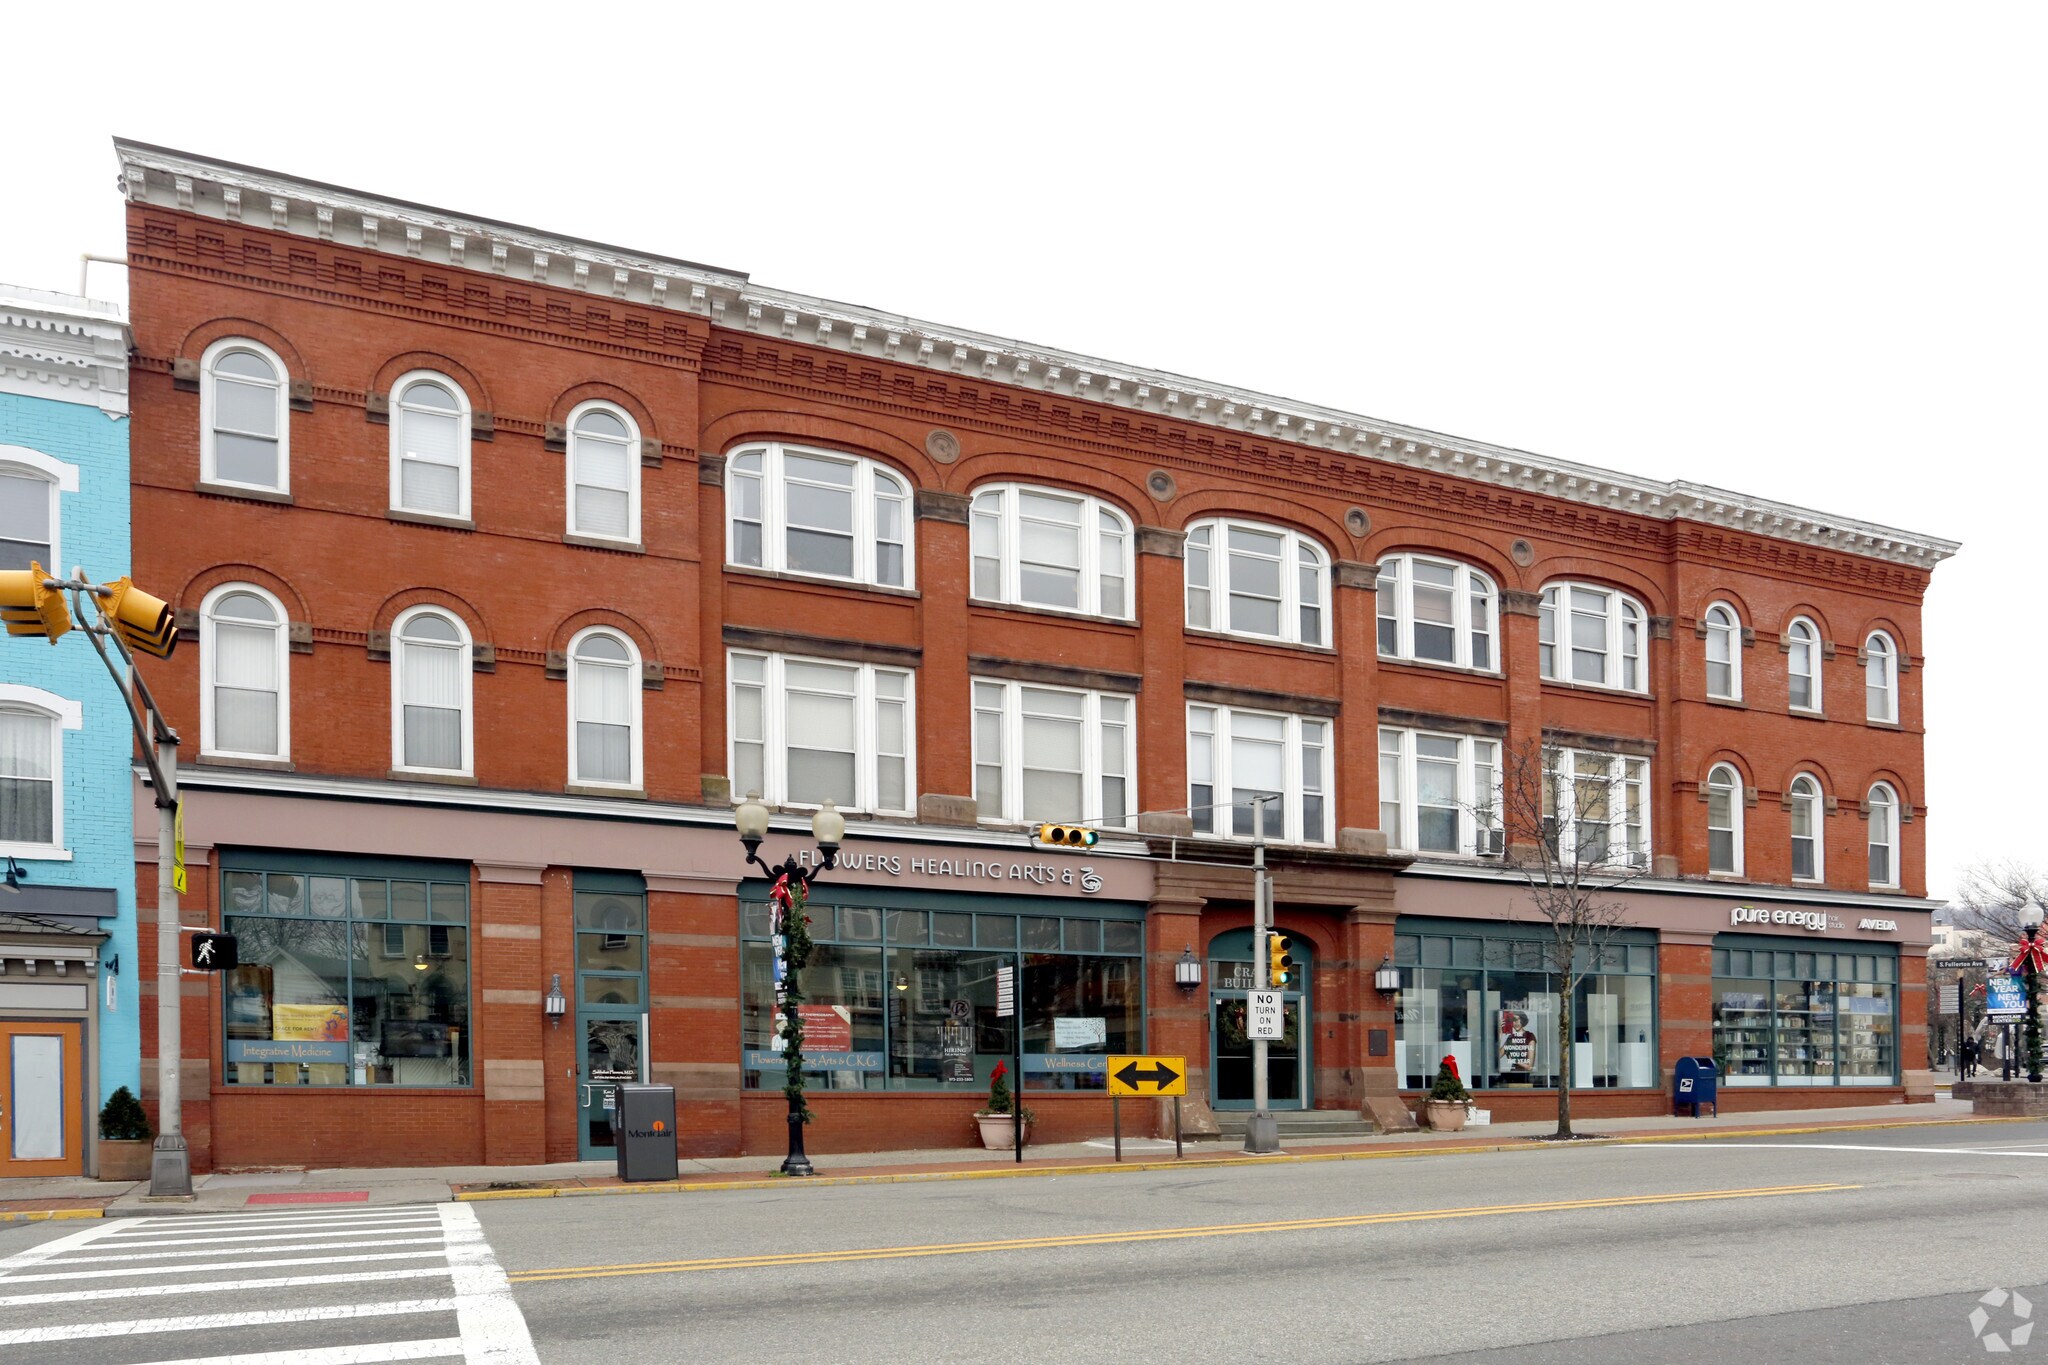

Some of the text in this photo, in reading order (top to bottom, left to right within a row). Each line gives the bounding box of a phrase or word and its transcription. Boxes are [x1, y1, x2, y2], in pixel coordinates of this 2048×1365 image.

[1061, 868, 1075, 885] &
[1771, 909, 1827, 931] energy
[1857, 918, 1898, 931] AVEDA
[1989, 978, 2012, 986] NEW
[1993, 985, 2018, 993] YEAR
[1257, 995, 1273, 1004] NO
[1997, 993, 2020, 1001] NEW
[1255, 1006, 1276, 1014] TURN
[243, 1042, 332, 1059] Integrative Medicine
[751, 1053, 783, 1066] Flowers
[818, 1054, 837, 1066] Arts
[1045, 1057, 1085, 1069] Wellness
[628, 1127, 672, 1138] Montclair
